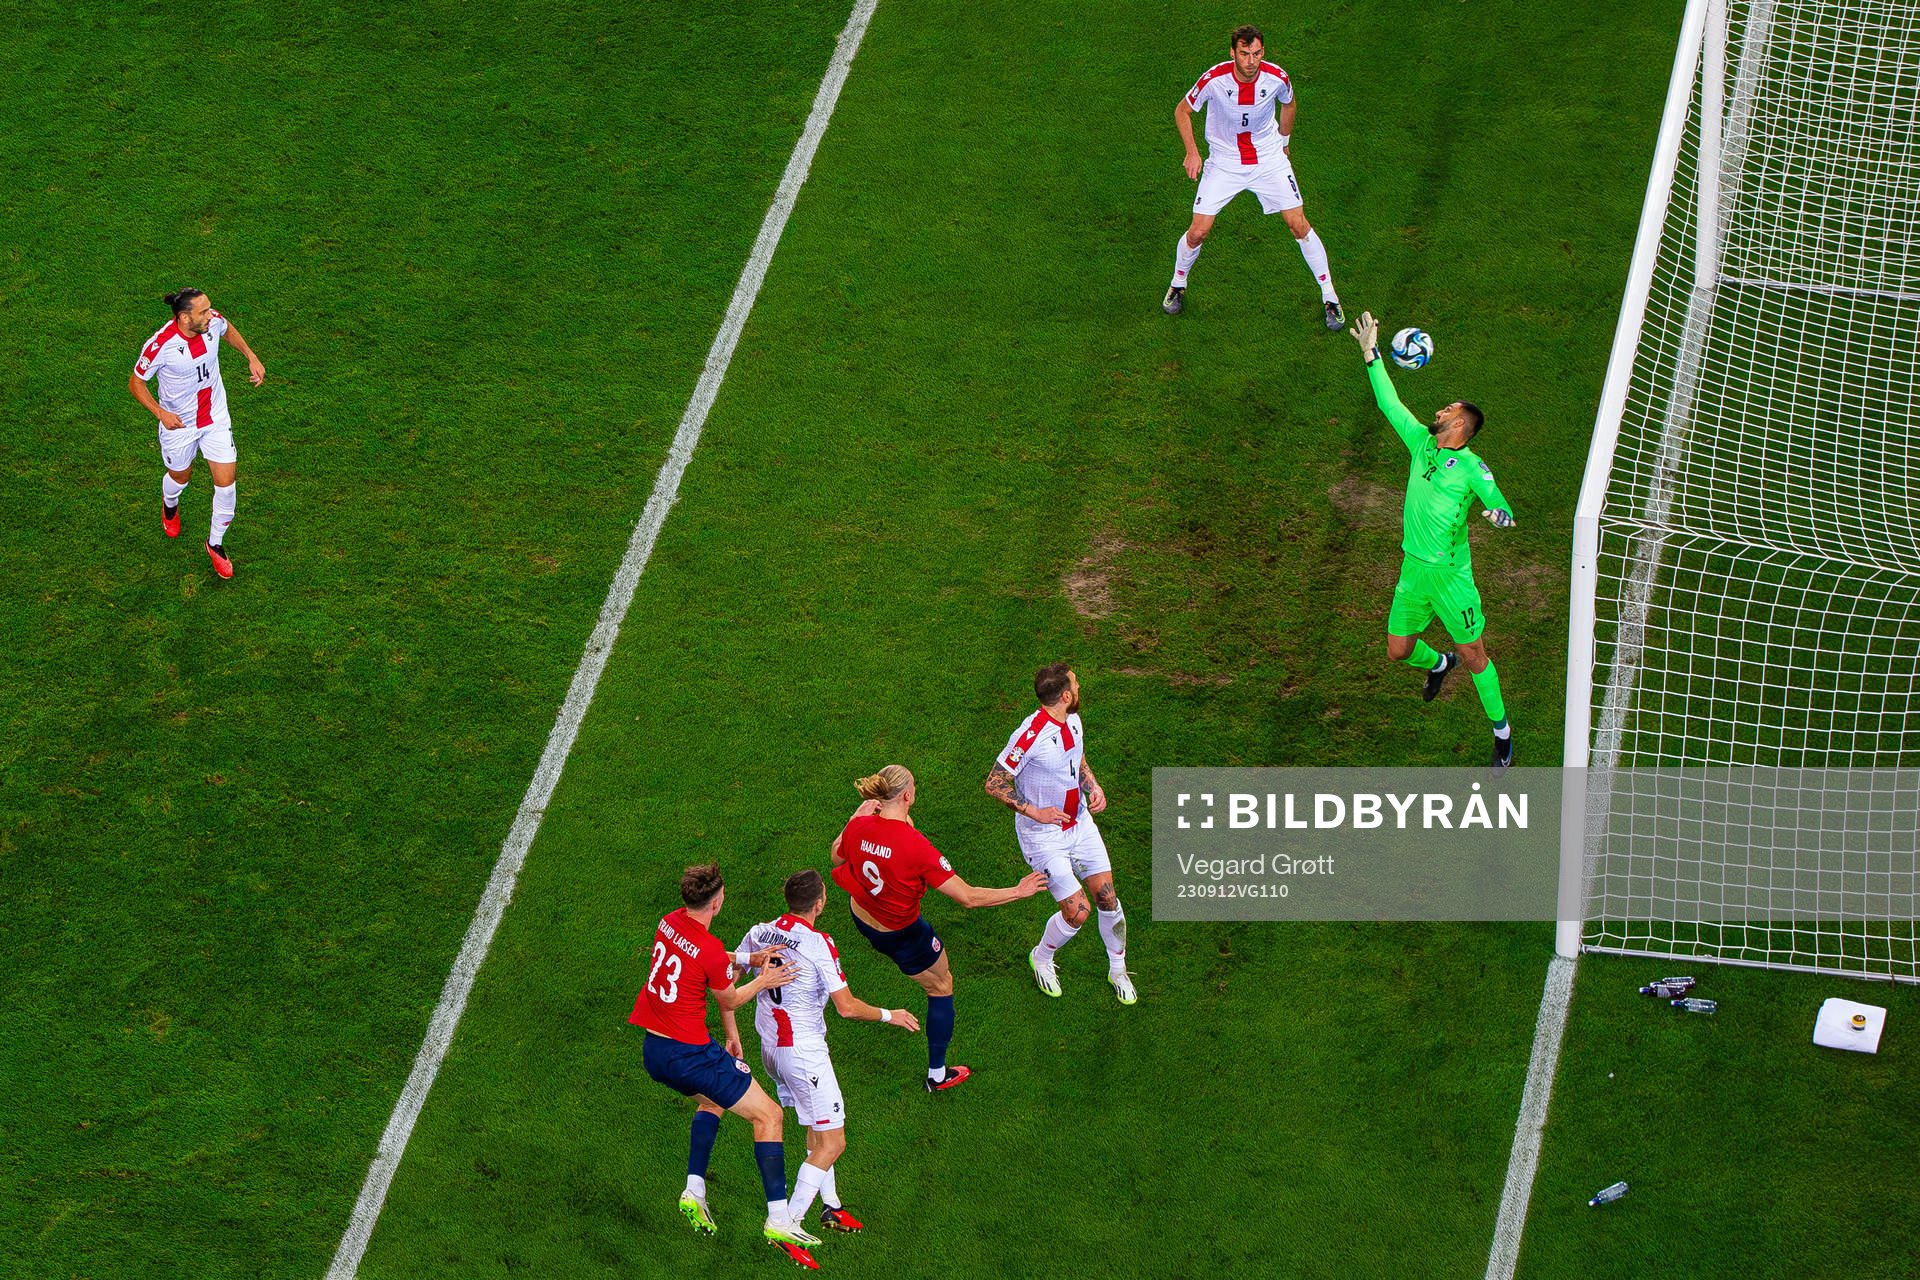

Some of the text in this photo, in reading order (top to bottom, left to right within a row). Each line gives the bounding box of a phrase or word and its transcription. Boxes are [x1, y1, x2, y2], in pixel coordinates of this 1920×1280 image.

[1241, 113, 1249, 127] 5
[1287, 174, 1297, 193] 5
[196, 362, 208, 382] 14
[1422, 465, 1437, 482] 12
[1460, 606, 1477, 630] 12
[1069, 759, 1076, 779] 4
[860, 839, 892, 859] HAALAND
[862, 860, 884, 897] 9
[672, 933, 701, 959] LARSEN
[647, 941, 683, 1004] 23
